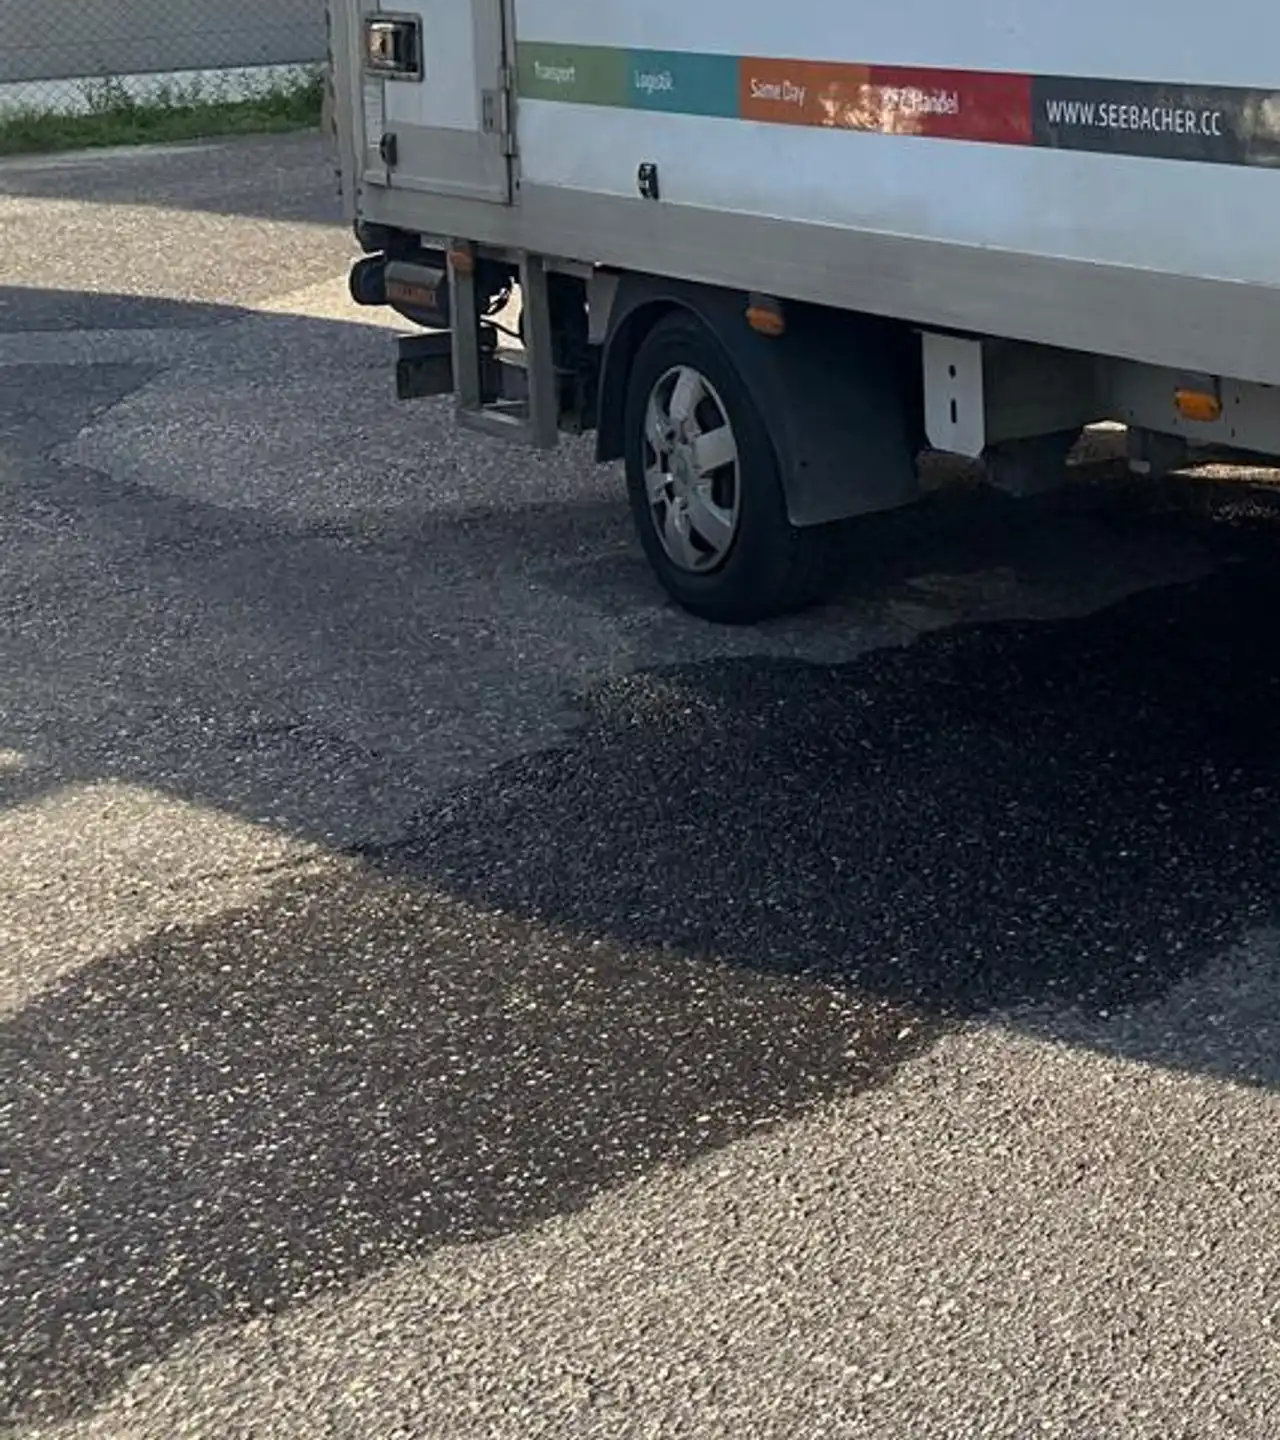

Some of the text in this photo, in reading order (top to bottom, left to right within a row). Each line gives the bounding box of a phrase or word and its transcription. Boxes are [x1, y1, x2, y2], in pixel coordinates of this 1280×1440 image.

[534, 61, 575, 85] Transport
[634, 70, 673, 95] Logistik
[783, 80, 806, 107] Day
[1046, 99, 1221, 136] WWW.SEEBACHER.CC
